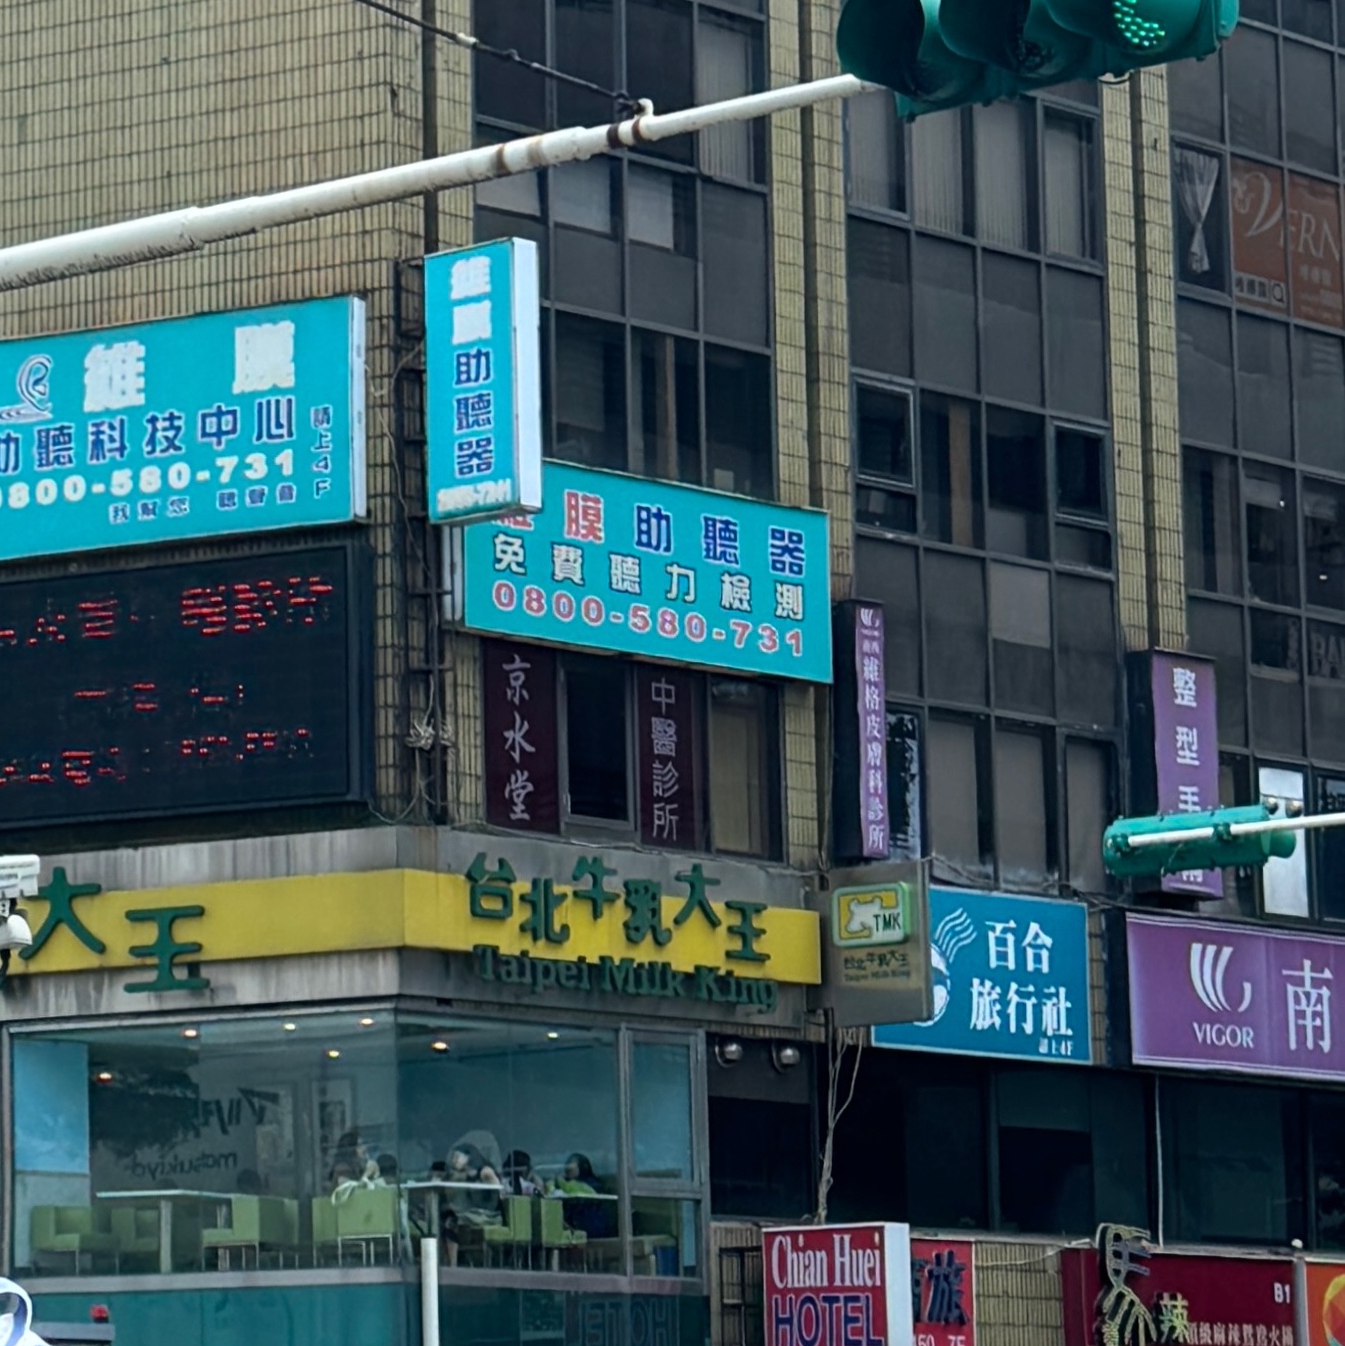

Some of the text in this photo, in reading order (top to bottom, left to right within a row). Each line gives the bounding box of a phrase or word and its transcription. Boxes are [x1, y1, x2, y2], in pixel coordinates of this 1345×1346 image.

[490, 489, 807, 577] 膜助聽器
[492, 533, 804, 621] 免費聽力檢測
[492, 580, 804, 656] 0800-580-731
[502, 652, 536, 822] 京水堂
[650, 675, 680, 842] 中醫診所
[1172, 667, 1204, 882] 整型手
[465, 850, 771, 964] 台北牛乳大王
[872, 911, 902, 933] TMK
[472, 944, 779, 1018] Taipei Milk King
[985, 919, 1053, 974] 百合
[970, 977, 1074, 1037] 旅行社
[1192, 1021, 1255, 1049] VIGOR
[1282, 958, 1333, 1054] 南
[772, 1231, 881, 1289] Chian Huei
[1273, 1282, 1291, 1304] B1
